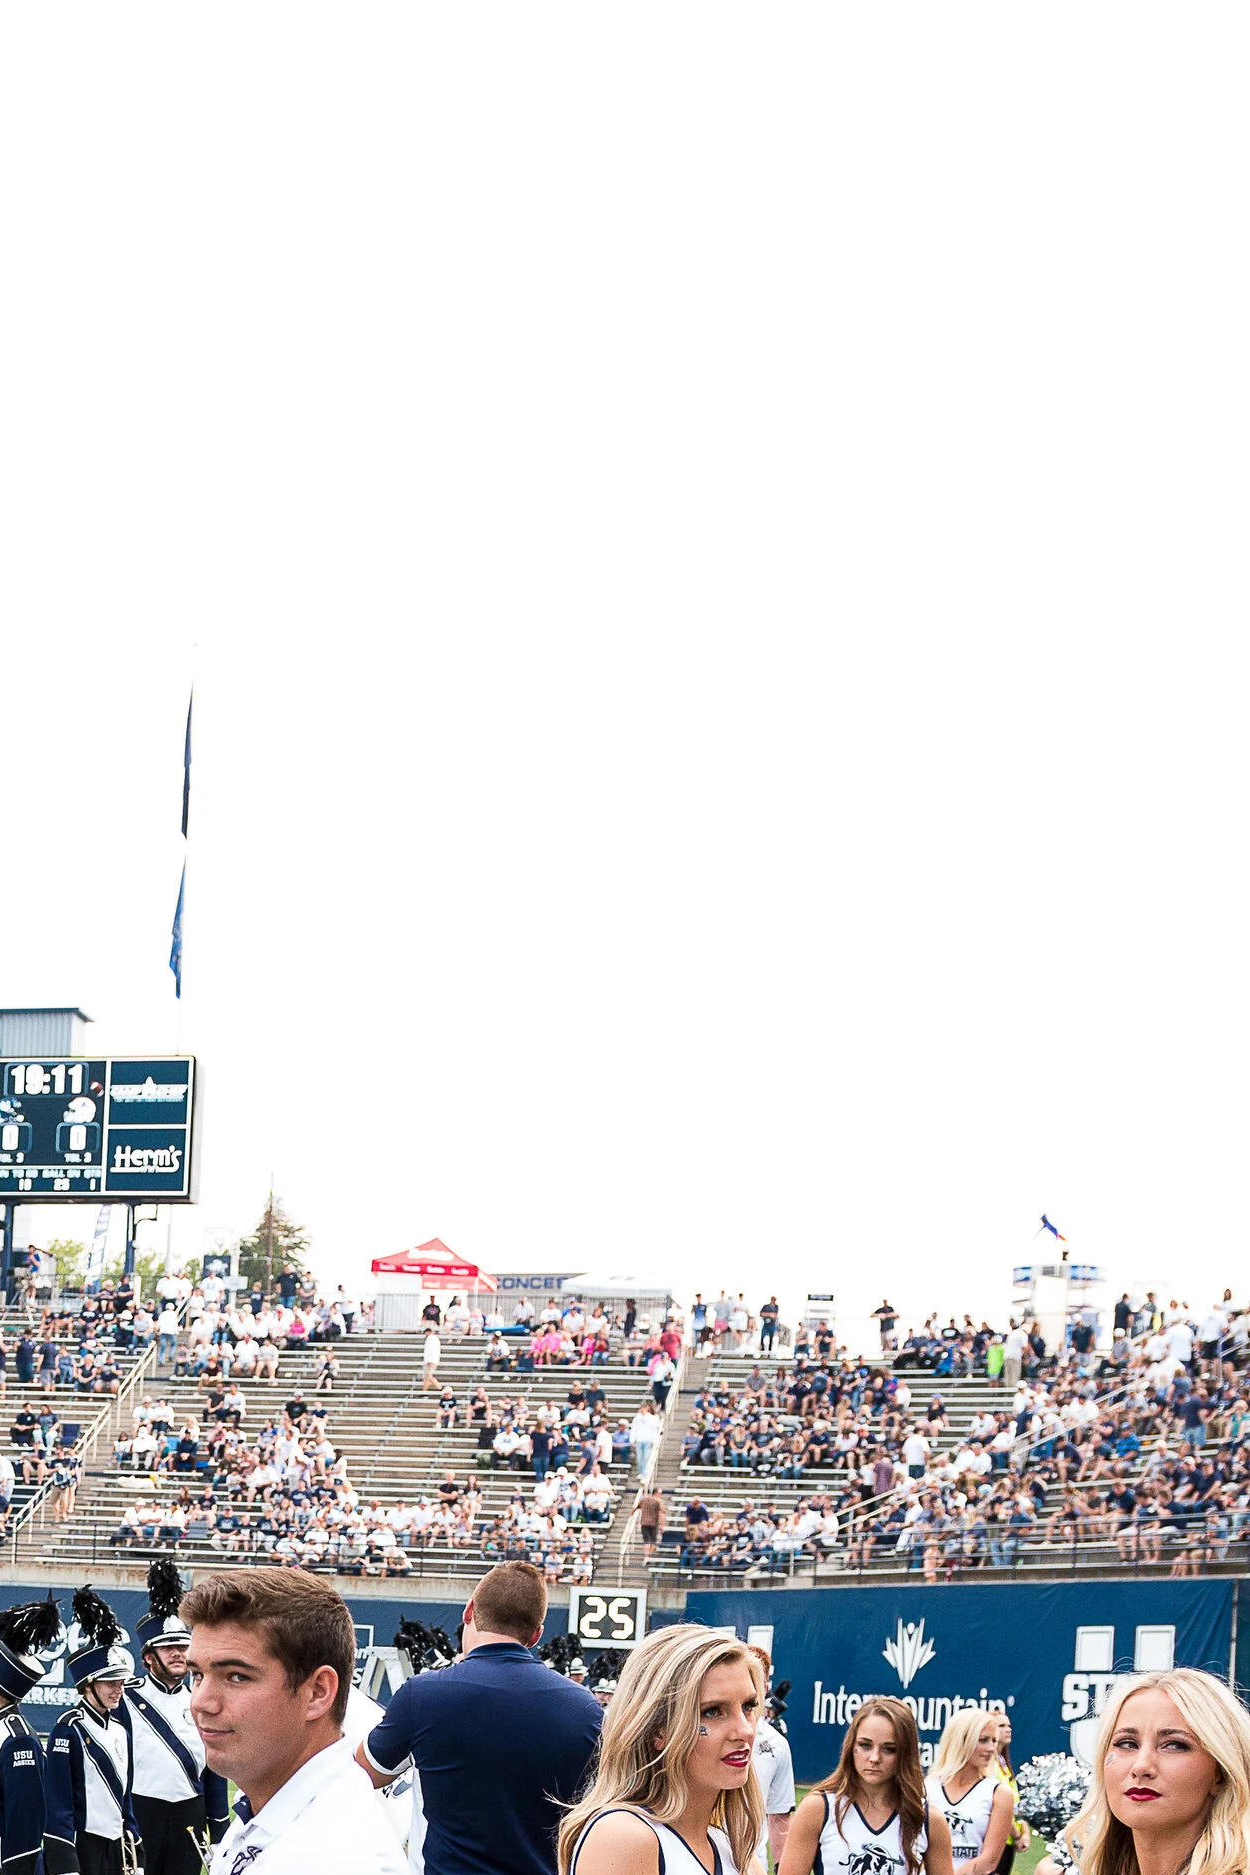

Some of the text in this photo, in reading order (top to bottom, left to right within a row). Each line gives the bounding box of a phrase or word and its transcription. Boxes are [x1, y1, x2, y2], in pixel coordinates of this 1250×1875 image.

[114, 1145, 182, 1173] Herm's
[579, 1596, 636, 1640] 25
[812, 1680, 1006, 1730] Inteountin
[13, 1750, 33, 1760] USU
